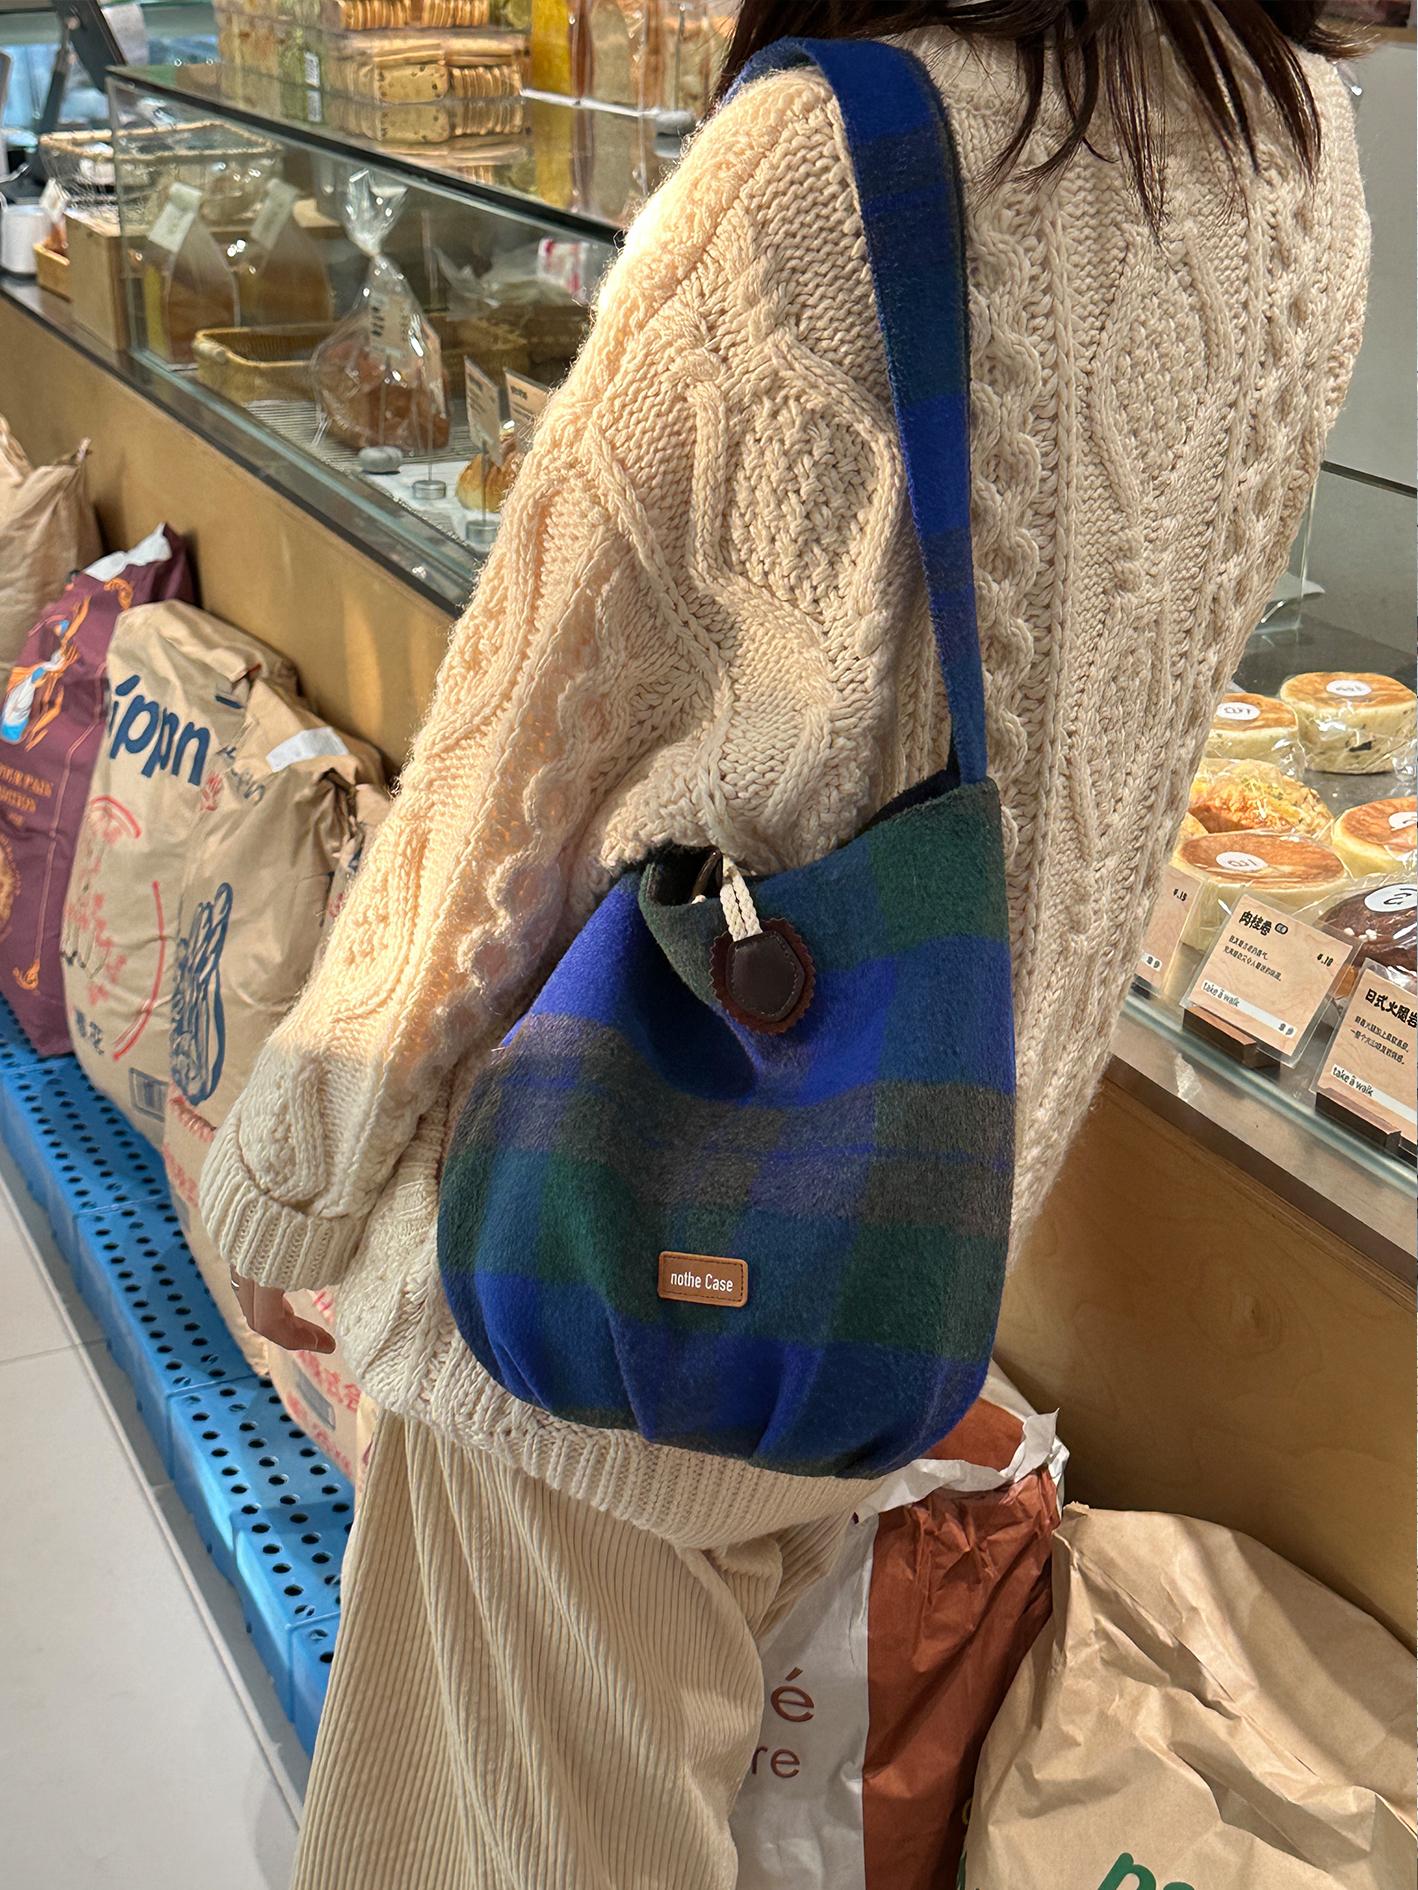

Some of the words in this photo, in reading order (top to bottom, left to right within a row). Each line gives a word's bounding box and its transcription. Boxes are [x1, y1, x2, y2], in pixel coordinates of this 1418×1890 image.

[1238, 910, 1273, 937] 肉桂卷
[1332, 1065, 1350, 1083] take
[1355, 1081, 1374, 1097] walk
[670, 1271, 702, 1289] nothe
[704, 1273, 734, 1293] Case
[751, 1746, 800, 1778] re
